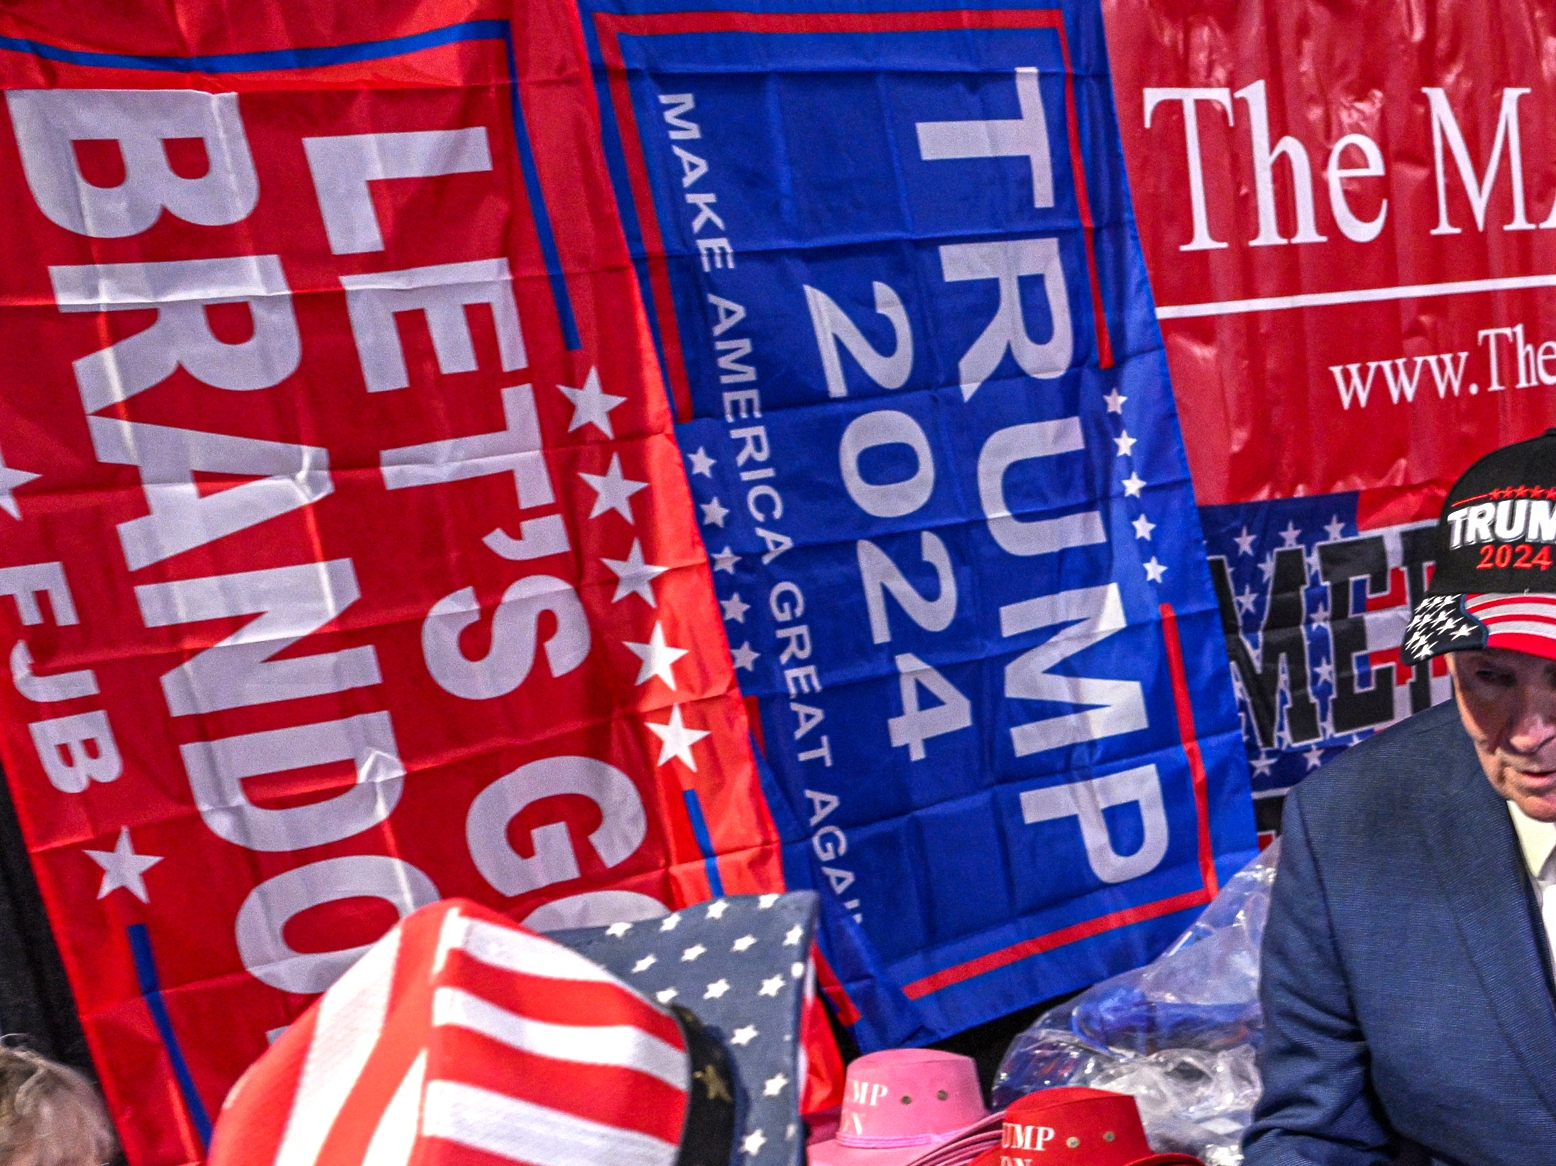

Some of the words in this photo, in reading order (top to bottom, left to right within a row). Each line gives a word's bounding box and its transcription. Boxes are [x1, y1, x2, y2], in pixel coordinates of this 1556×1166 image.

[1142, 79, 1389, 252] The
[5, 89, 442, 1046] BRANDO
[303, 126, 592, 700] LET'S
[658, 92, 735, 273] MAKE
[707, 293, 793, 567] AMERICA
[769, 580, 833, 770] GREAT
[804, 281, 973, 762] 2024
[916, 67, 1169, 884] TRUMP
[1476, 543, 1554, 572] 2024
[0, 560, 124, 794] FJB
[1002, 1122, 1056, 1153] UMP
